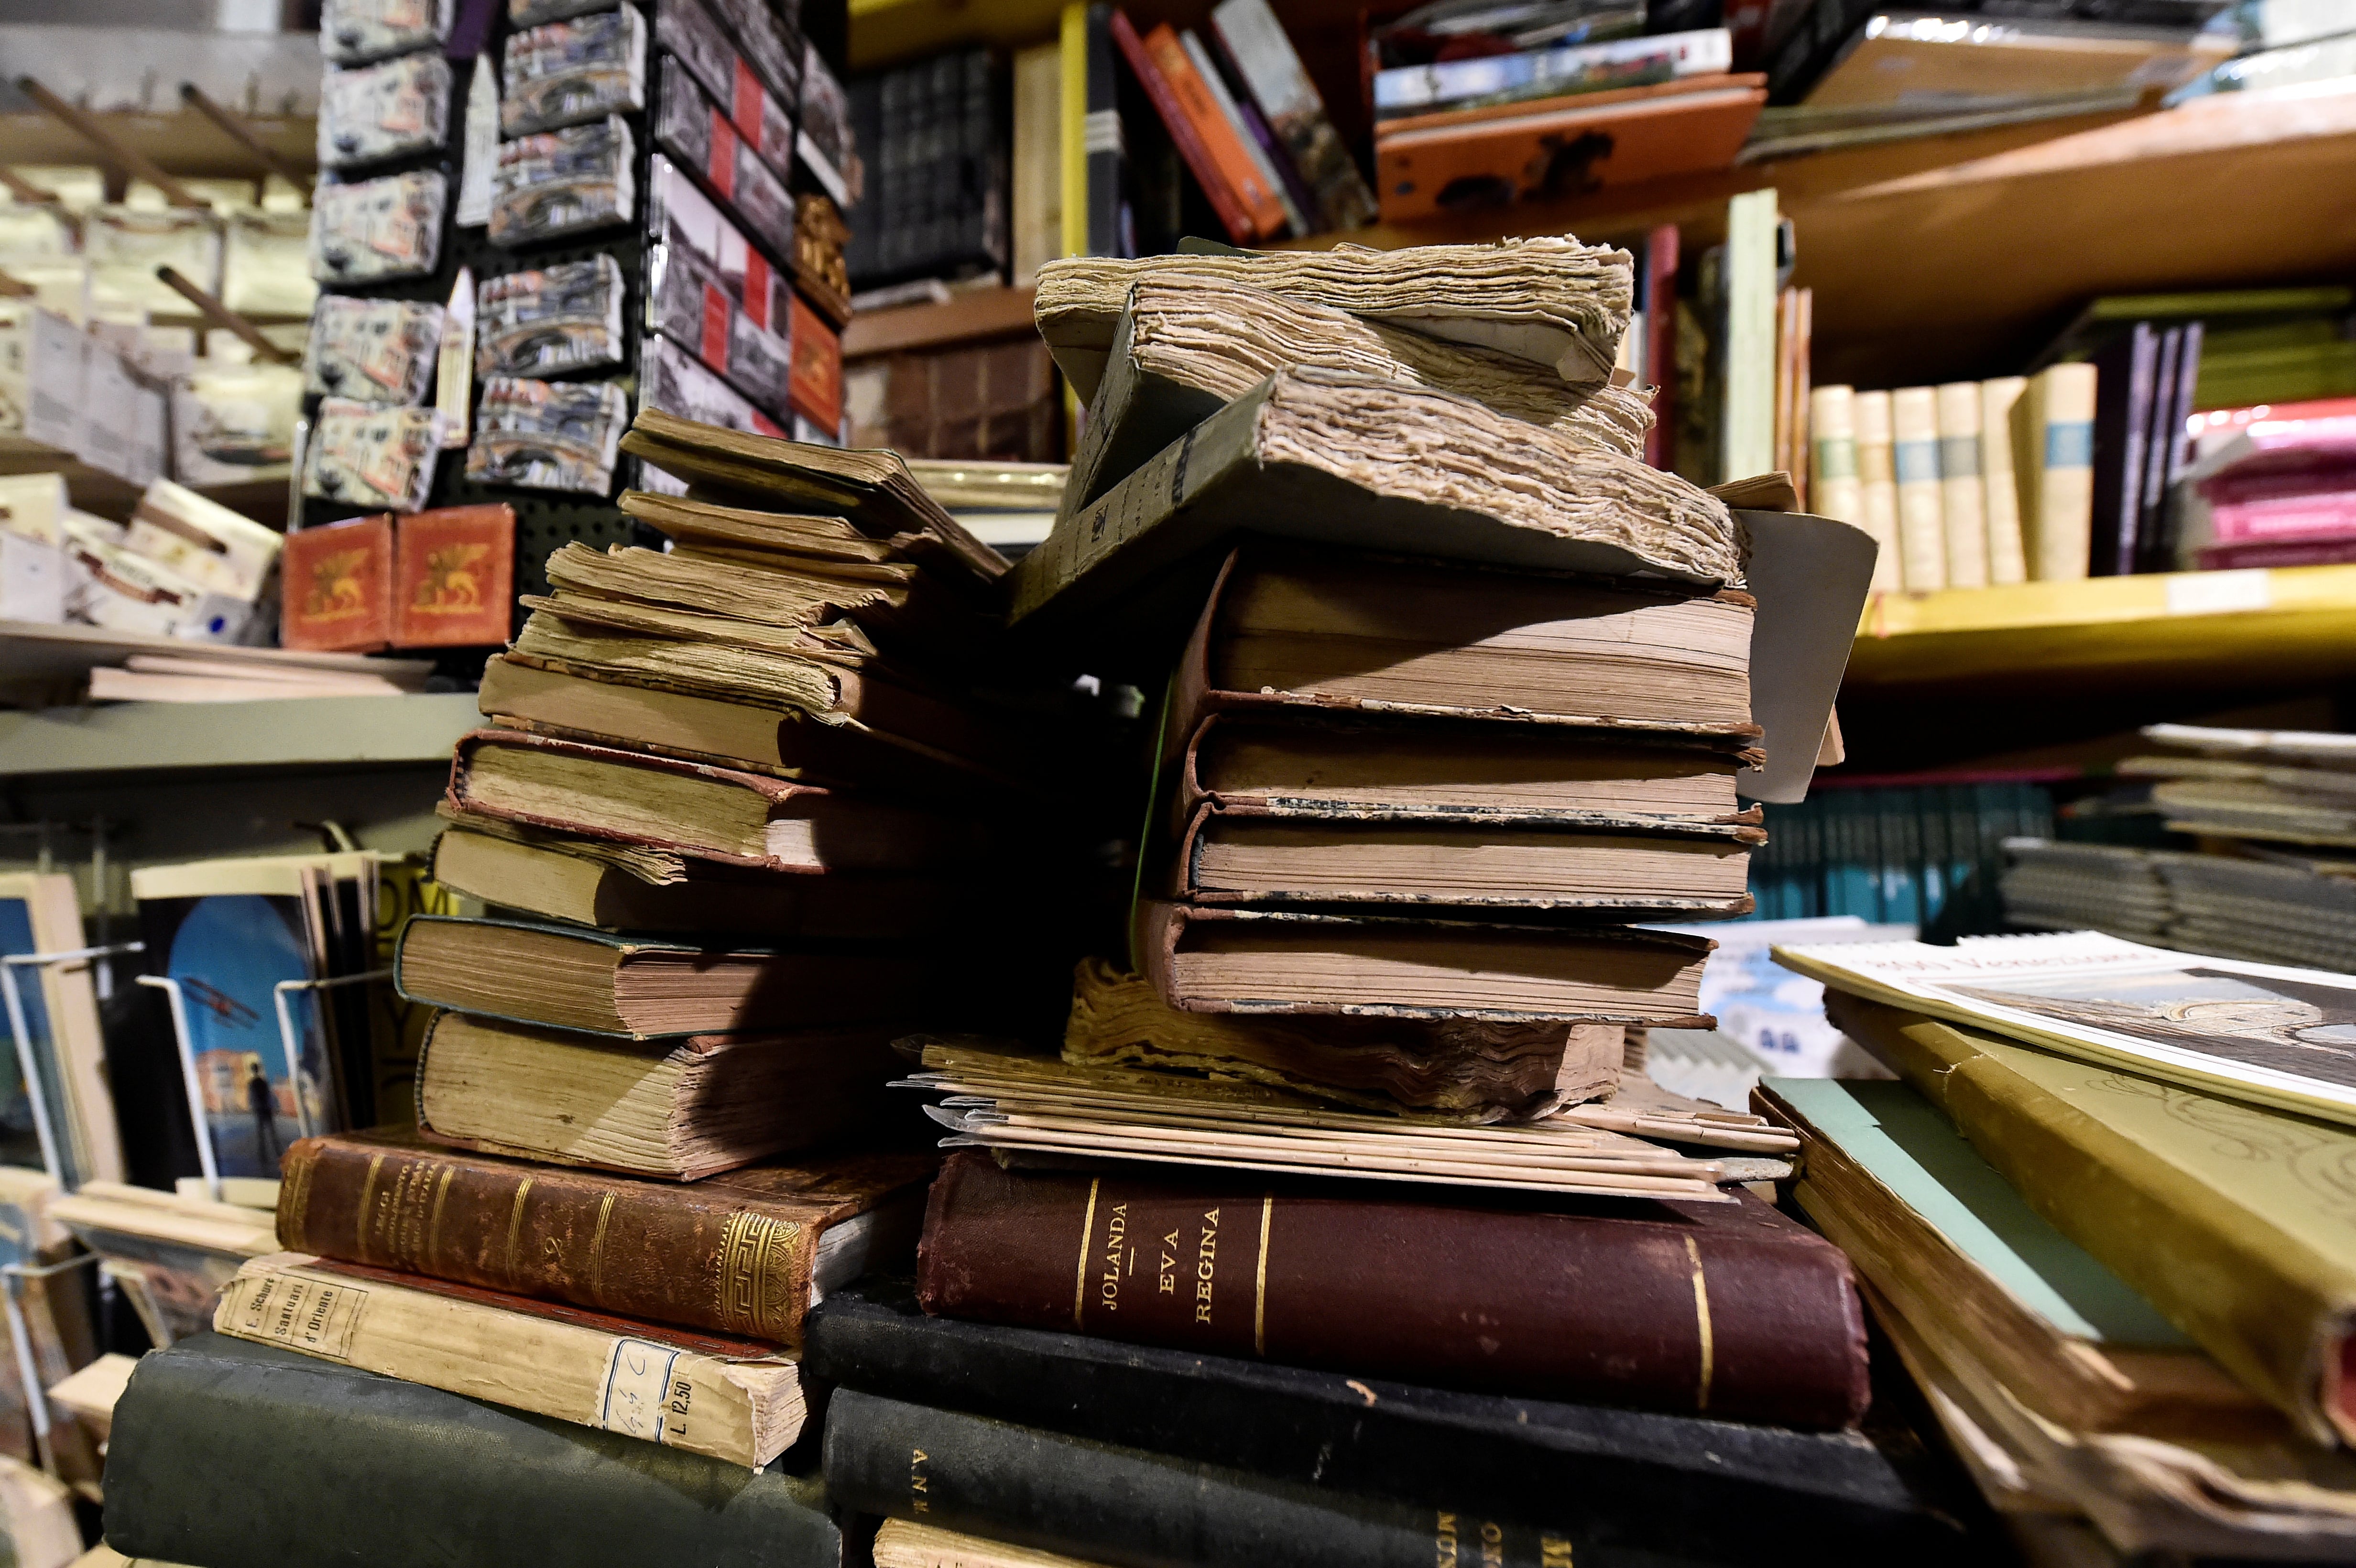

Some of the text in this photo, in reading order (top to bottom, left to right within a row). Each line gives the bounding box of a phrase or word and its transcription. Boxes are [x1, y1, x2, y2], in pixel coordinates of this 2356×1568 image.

[1102, 1202, 1127, 1311] JOLANDA
[1159, 1228, 1179, 1295] EVA
[1196, 1207, 1220, 1325] REGINA
[246, 1318, 260, 1331] E.
[274, 1284, 304, 1336] Santuari
[670, 1381, 692, 1436] L. 12,50
